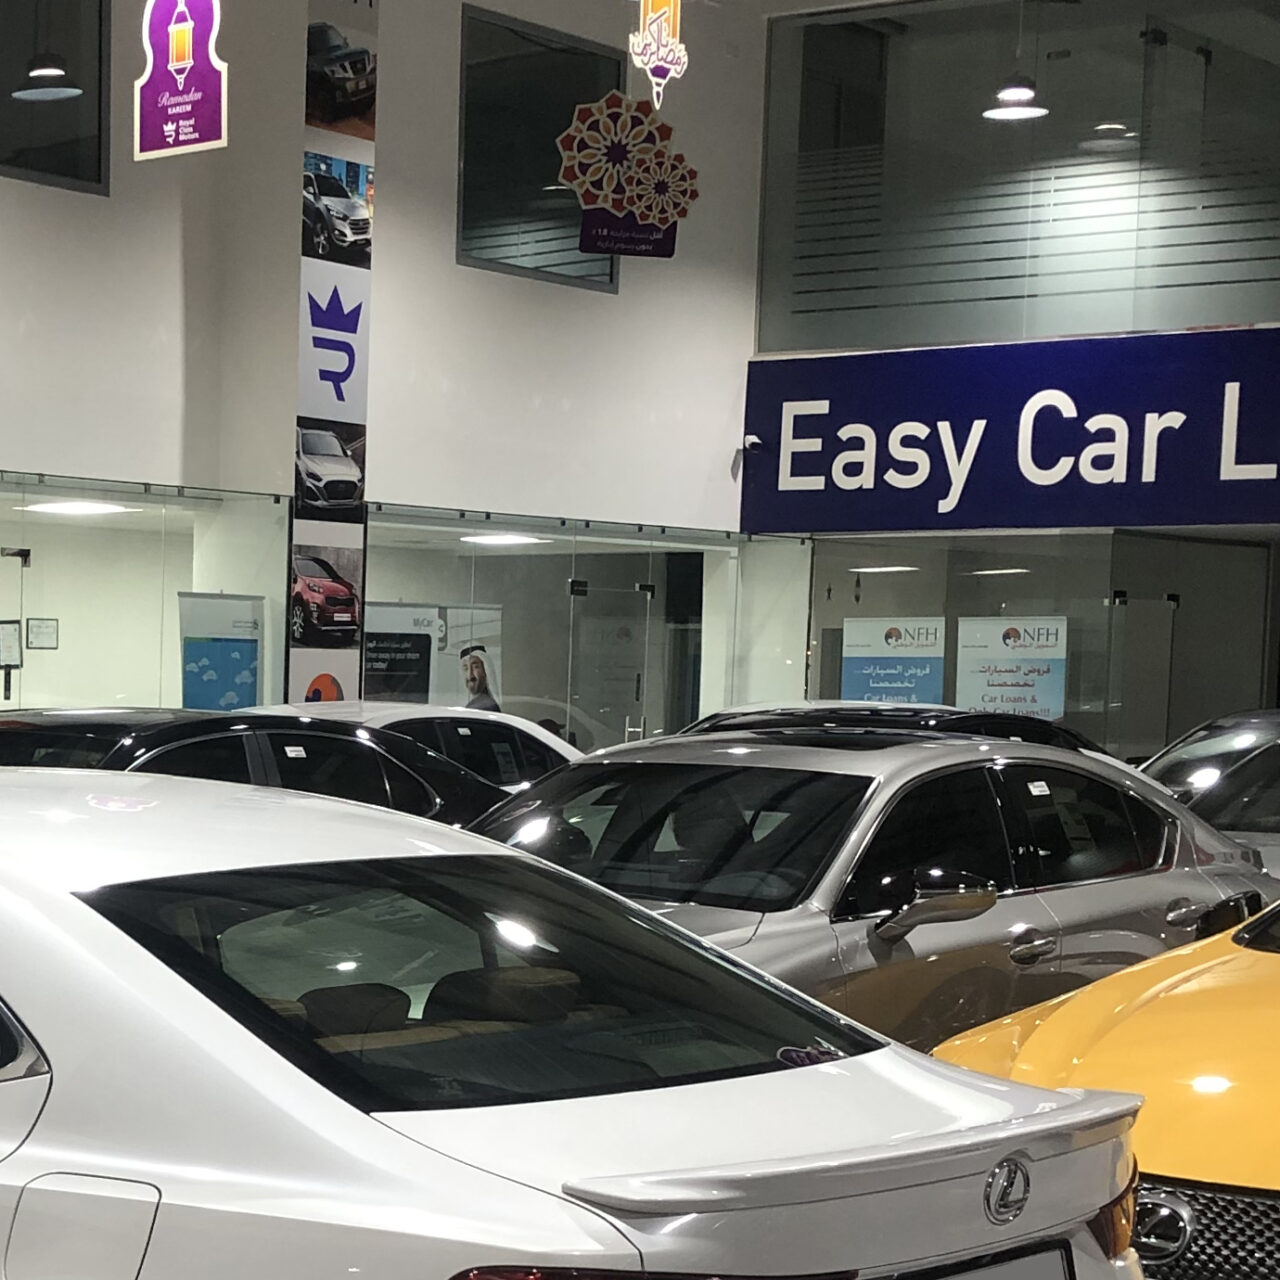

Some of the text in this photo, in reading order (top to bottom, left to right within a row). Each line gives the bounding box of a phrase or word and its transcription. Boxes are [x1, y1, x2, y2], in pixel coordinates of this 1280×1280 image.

[778, 400, 987, 514] Easy
[1017, 389, 1187, 486] Car
[904, 627, 937, 641] NFH
[1023, 627, 1058, 642] NFH
[904, 664, 931, 676] قروض
[1023, 664, 1051, 676] قروض
[981, 694, 1038, 703] Car Loans &
